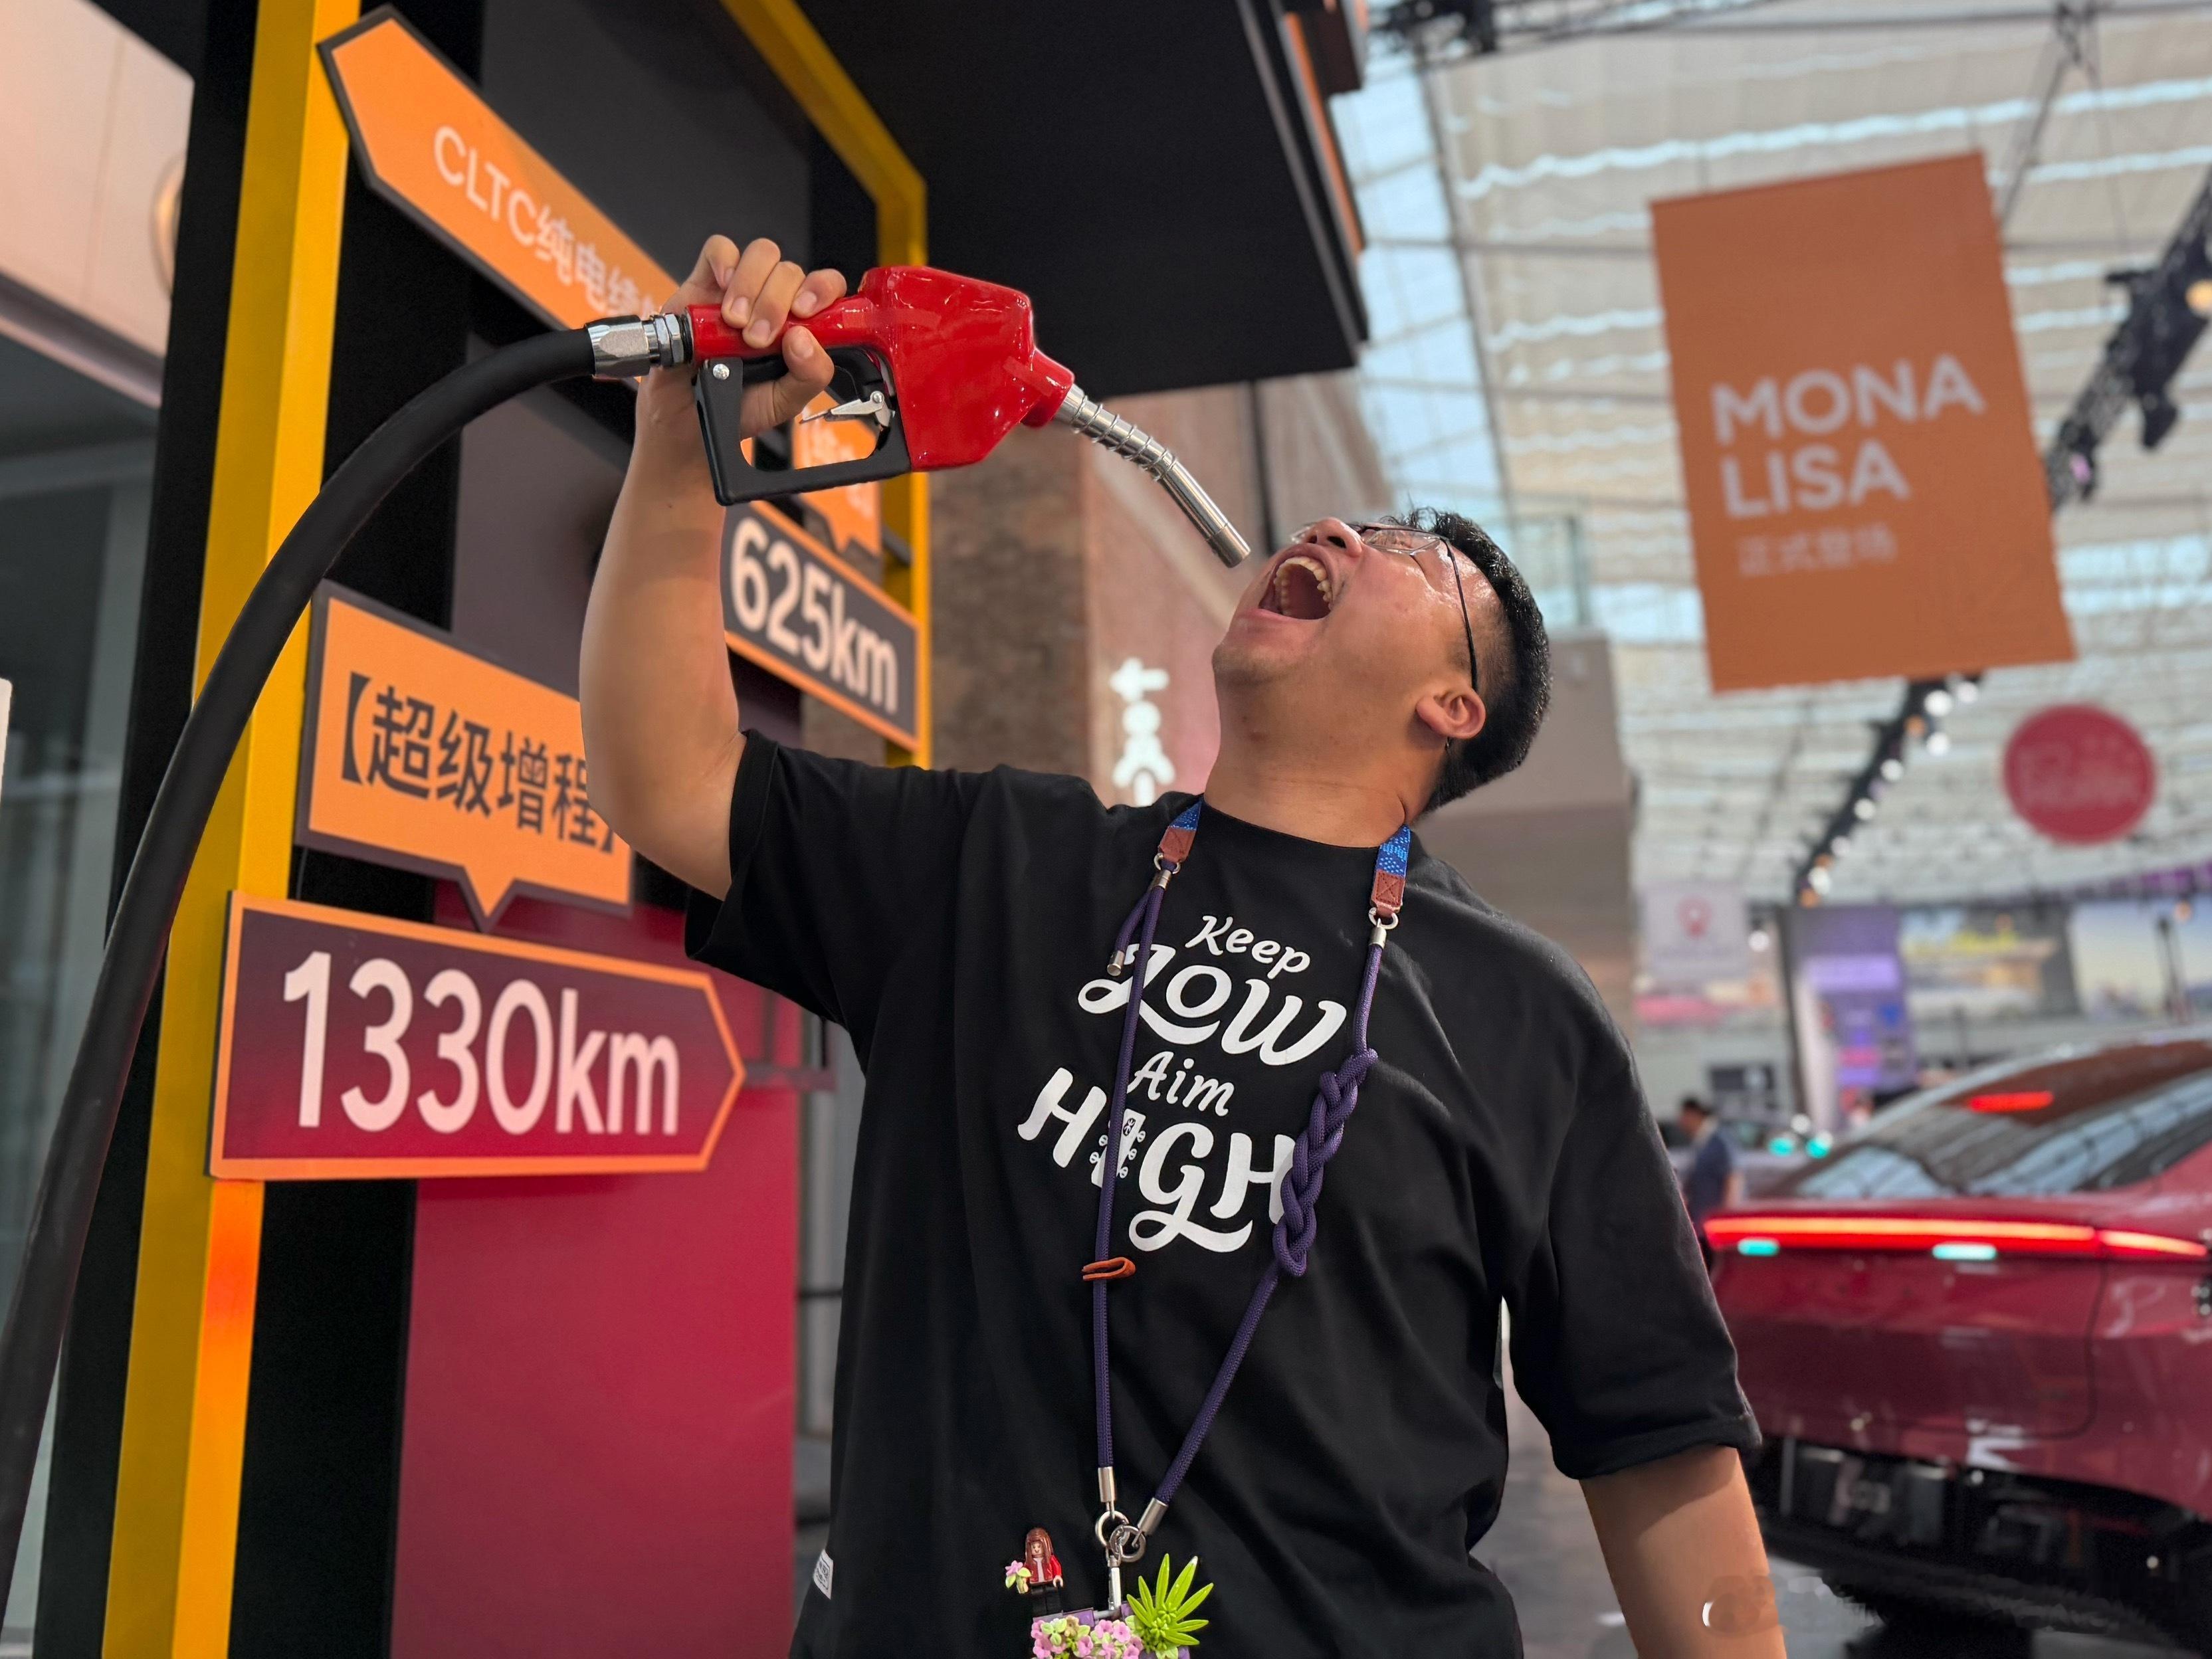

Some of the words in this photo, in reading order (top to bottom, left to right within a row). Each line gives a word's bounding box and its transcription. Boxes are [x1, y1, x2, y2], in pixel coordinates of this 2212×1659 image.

[433, 126, 655, 317] CLTC纯电续
[1712, 354, 1984, 443] MONA
[1721, 440, 1909, 518] LISA
[732, 518, 898, 714] 625km
[342, 672, 613, 854] 【超级增程
[1078, 943, 1348, 1066] LOW
[1185, 915, 1311, 980] Keep
[284, 951, 679, 1135] 1330km
[1126, 1051, 1235, 1117] Aim
